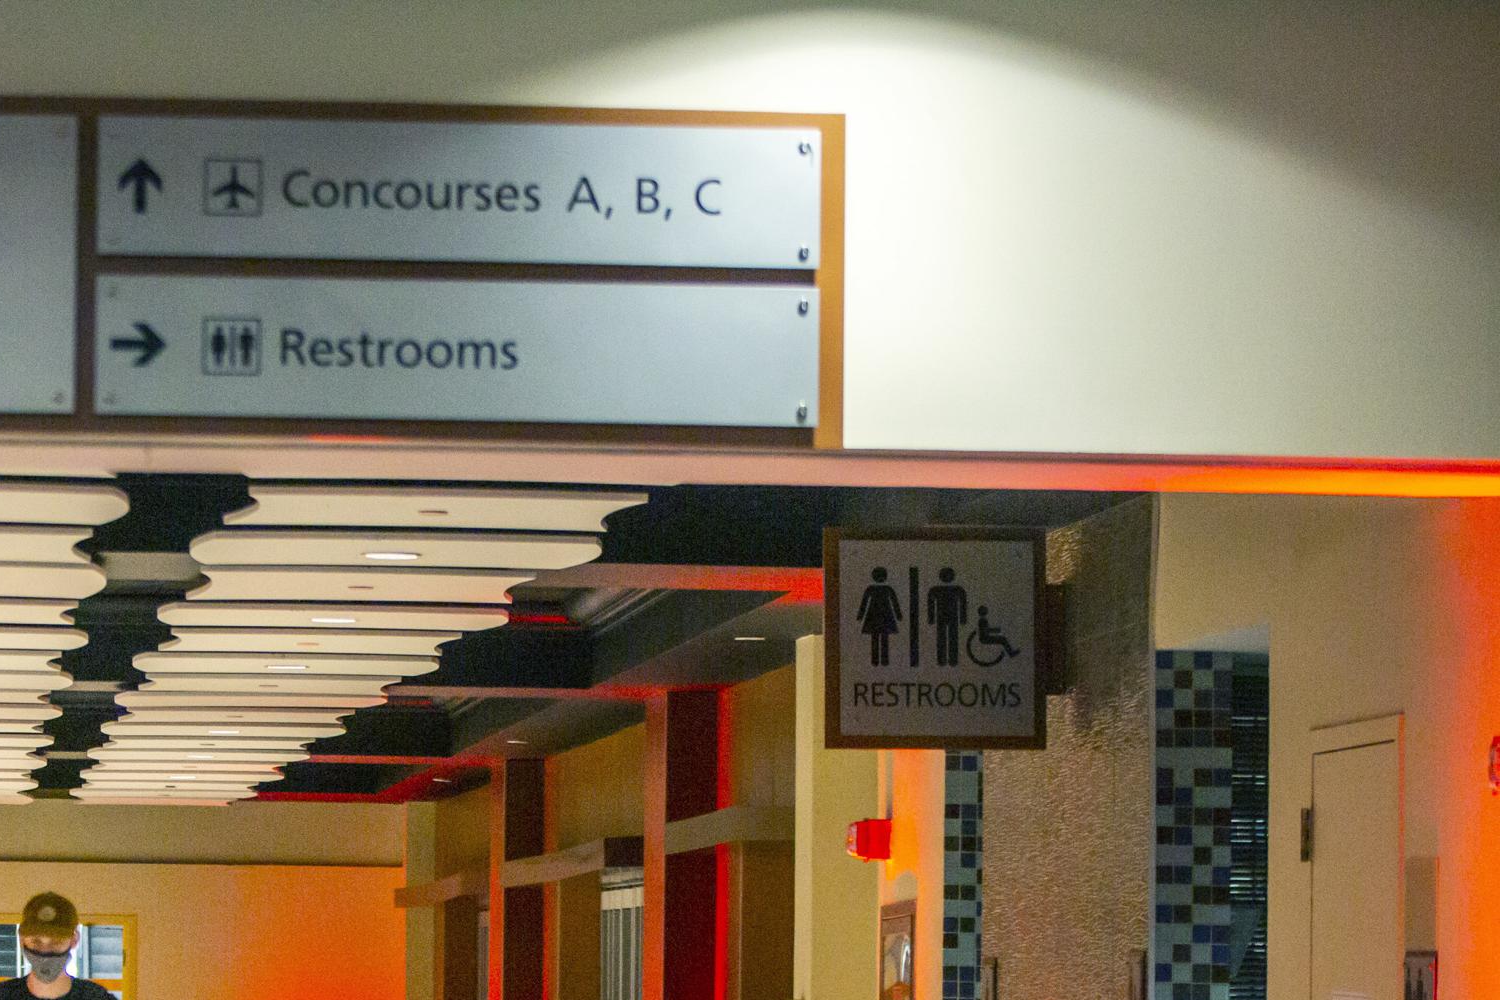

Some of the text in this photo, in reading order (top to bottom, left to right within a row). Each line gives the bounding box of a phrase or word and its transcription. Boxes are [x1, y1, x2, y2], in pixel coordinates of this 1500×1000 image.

[283, 169, 721, 221] Concourses A, B, C
[279, 327, 519, 370] Restrooms
[853, 682, 1022, 708] RESTROOMS
